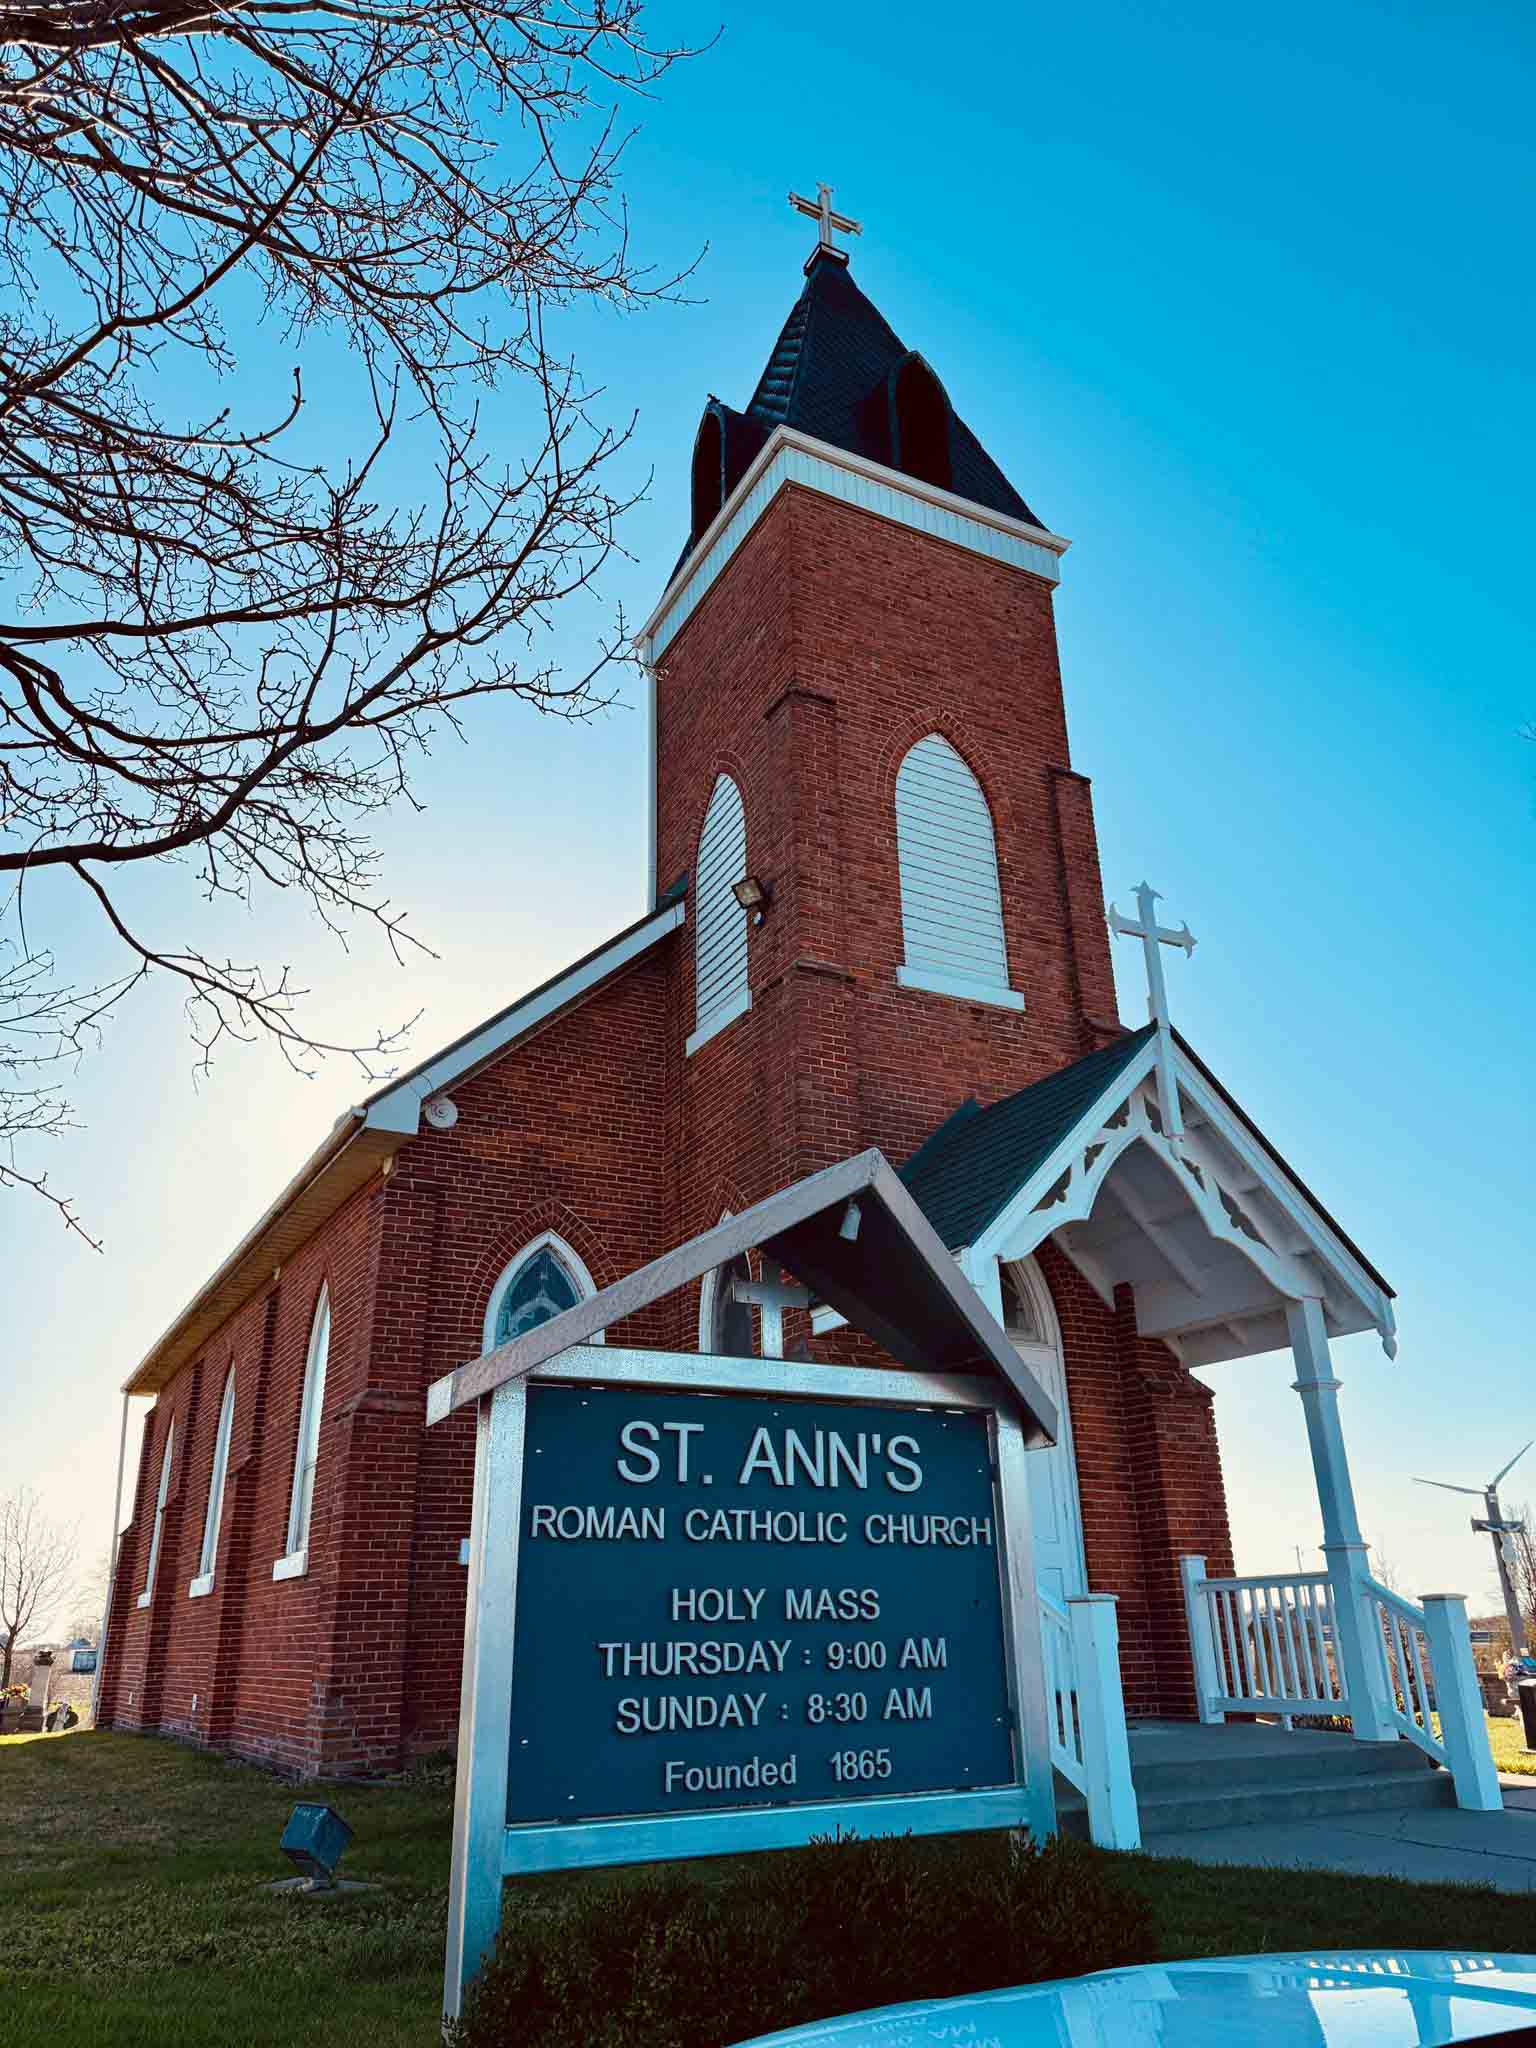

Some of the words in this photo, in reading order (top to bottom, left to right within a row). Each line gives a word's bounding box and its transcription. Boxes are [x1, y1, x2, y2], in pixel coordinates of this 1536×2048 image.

[617, 1420, 714, 1484] ST.
[739, 1427, 923, 1492] ANN'S
[532, 1505, 665, 1539] ROMAN
[685, 1508, 848, 1543] CATHOLIC
[865, 1514, 992, 1546] CHURCH
[672, 1588, 766, 1621] HOLY
[786, 1588, 880, 1620] MASS
[599, 1639, 792, 1678] THURSDAY
[828, 1641, 887, 1670] 9:00
[900, 1638, 947, 1668] AM
[616, 1693, 767, 1733] SUNDAY
[808, 1693, 867, 1723] 8:30
[884, 1688, 932, 1719] AM
[665, 1755, 796, 1793] Founded
[831, 1749, 892, 1781] 1865
